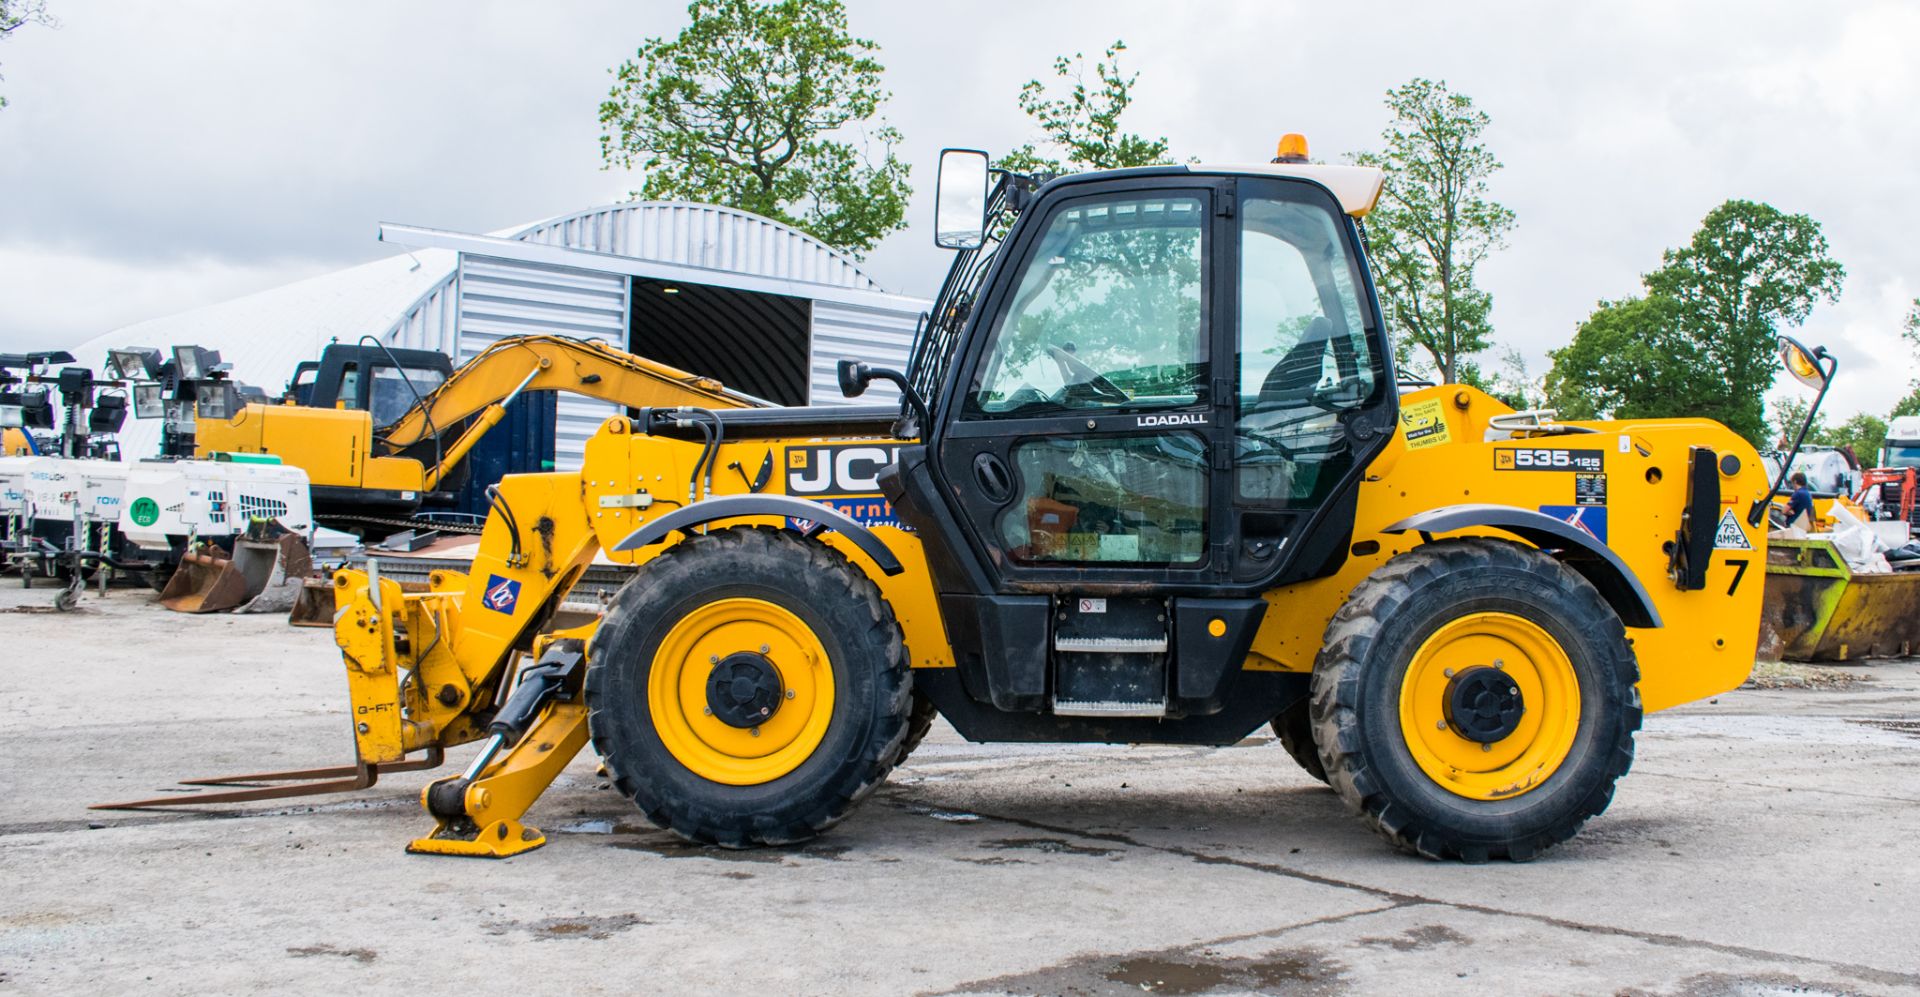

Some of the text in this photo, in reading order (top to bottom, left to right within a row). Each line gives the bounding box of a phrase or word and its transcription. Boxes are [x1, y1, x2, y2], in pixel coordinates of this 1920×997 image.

[1136, 414, 1208, 427] LOADALL
[1410, 434, 1447, 448] THUMBS UP
[789, 448, 900, 492] JC
[1723, 523, 1736, 534] 75
[1716, 534, 1742, 545] AM9E
[1725, 559, 1749, 596] 7
